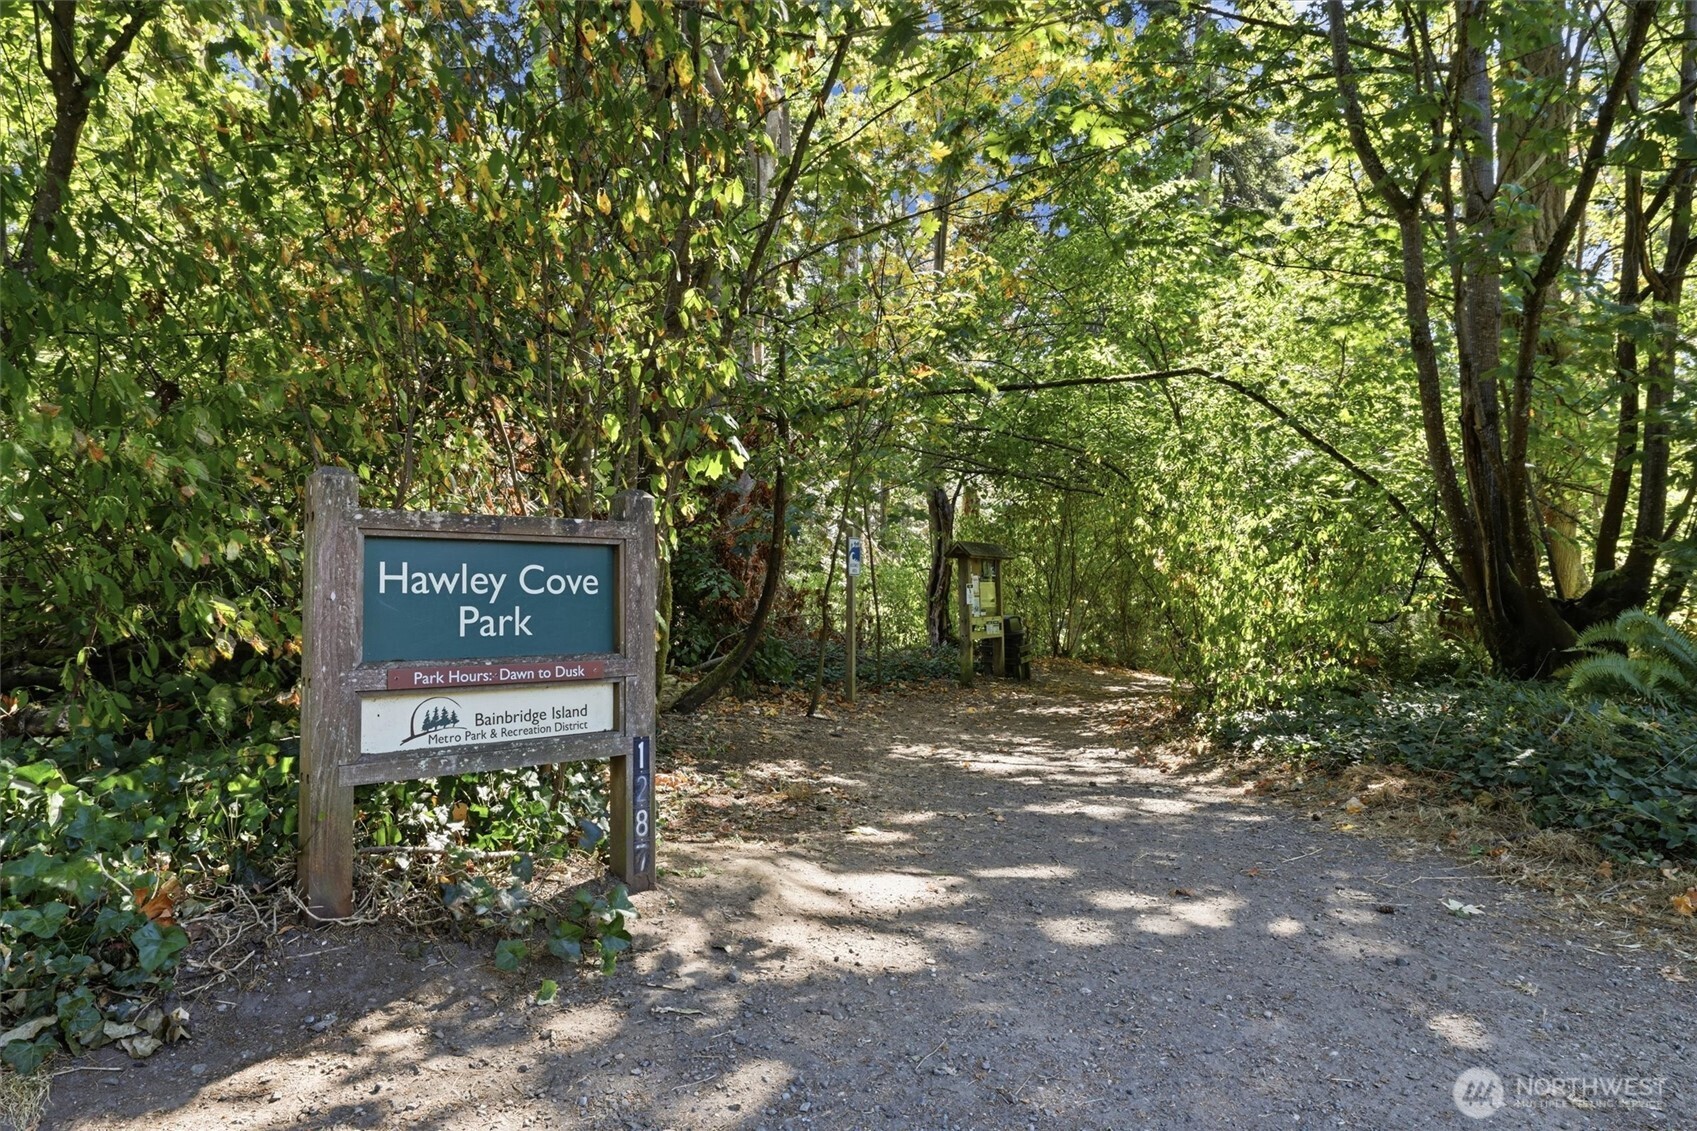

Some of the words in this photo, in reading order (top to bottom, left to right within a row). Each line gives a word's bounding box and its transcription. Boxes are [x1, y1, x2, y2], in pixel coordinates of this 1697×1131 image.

[379, 561, 506, 604] Hawley
[519, 564, 599, 595] Cove
[459, 606, 533, 637] Park
[414, 671, 444, 685] Park
[448, 669, 493, 683] Hours:
[500, 667, 535, 681] Dawn
[538, 668, 551, 679] to
[555, 665, 585, 678] Dusk
[475, 707, 547, 727] Bainbridge
[552, 704, 588, 719] Island
[428, 734, 461, 745] Metro
[465, 730, 487, 742] Park
[490, 730, 498, 739] &
[501, 725, 551, 738] Recreation
[554, 721, 588, 733] District
